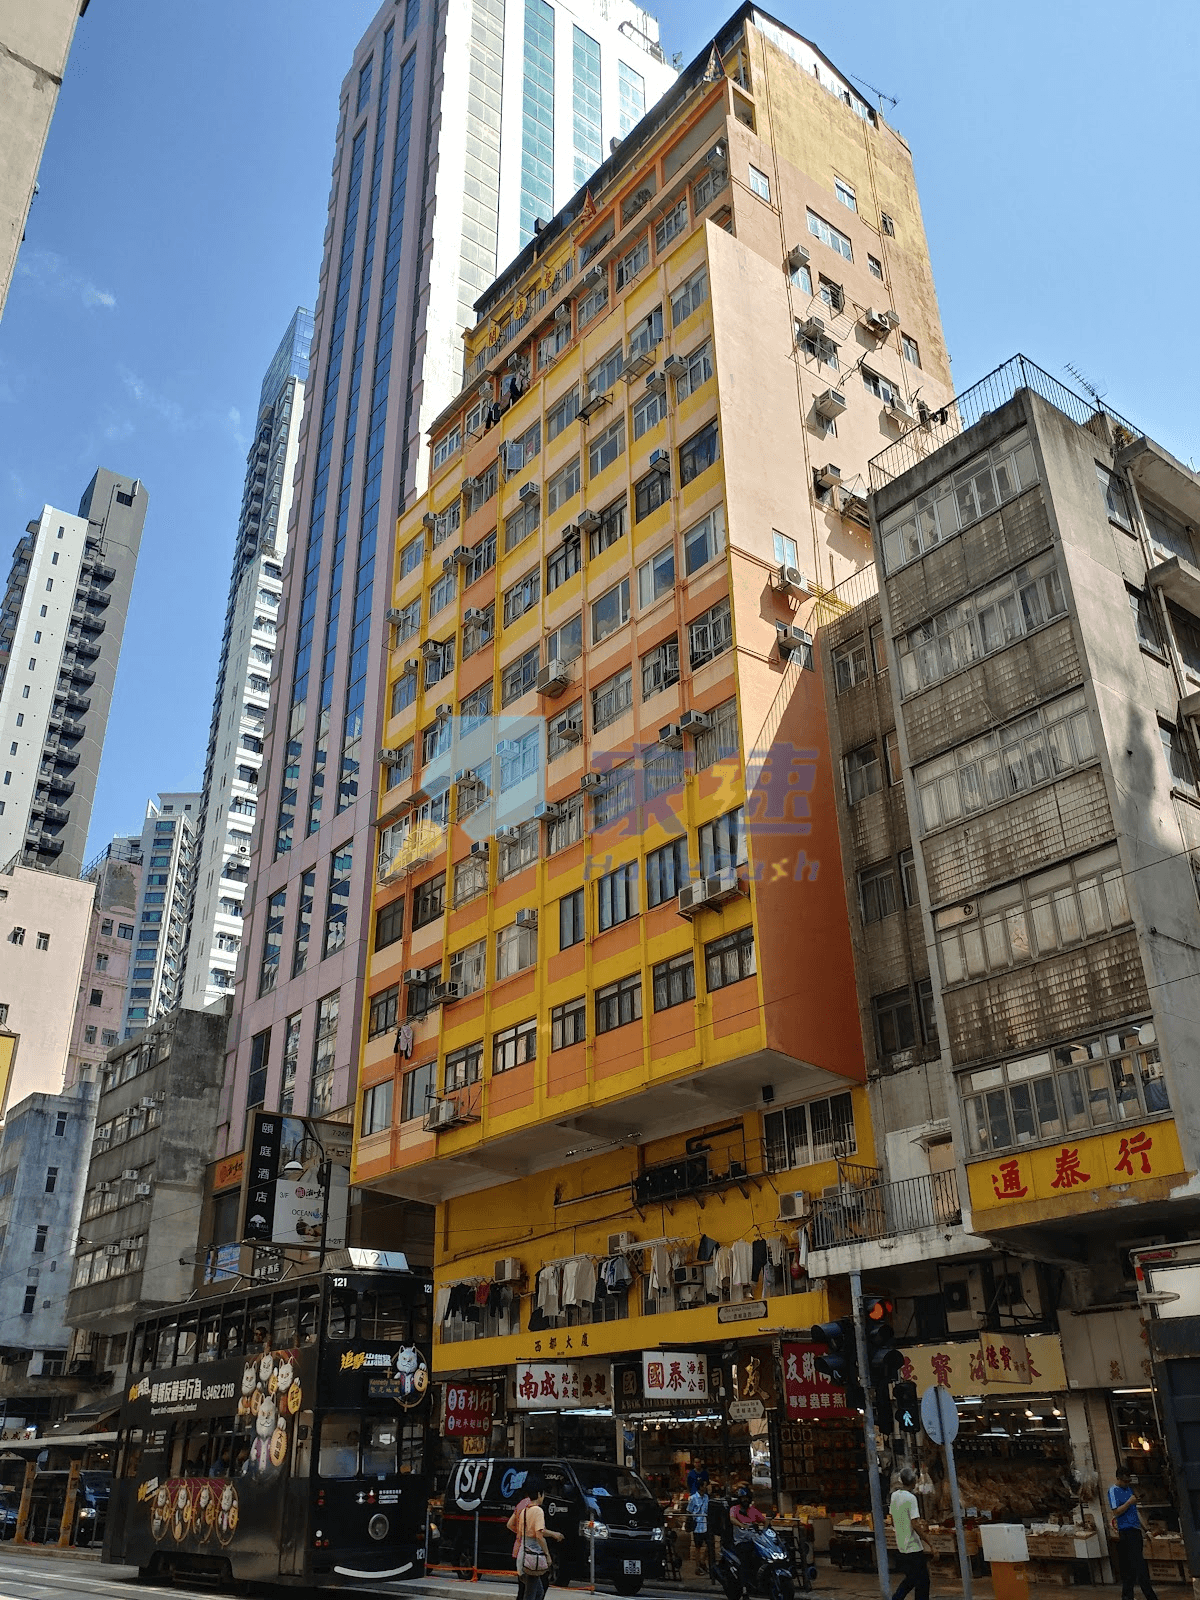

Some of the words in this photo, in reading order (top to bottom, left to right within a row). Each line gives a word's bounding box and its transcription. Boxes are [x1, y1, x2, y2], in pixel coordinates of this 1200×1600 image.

[255, 1122, 274, 1204] 頤庭酒店
[991, 1131, 1153, 1199] 通泰行
[291, 1209, 313, 1217] OCEAN
[332, 1277, 348, 1287] 121
[423, 1284, 433, 1293] 121
[519, 1371, 559, 1400] 南成
[647, 1361, 686, 1391] 國泰
[687, 1379, 706, 1392] 公司
